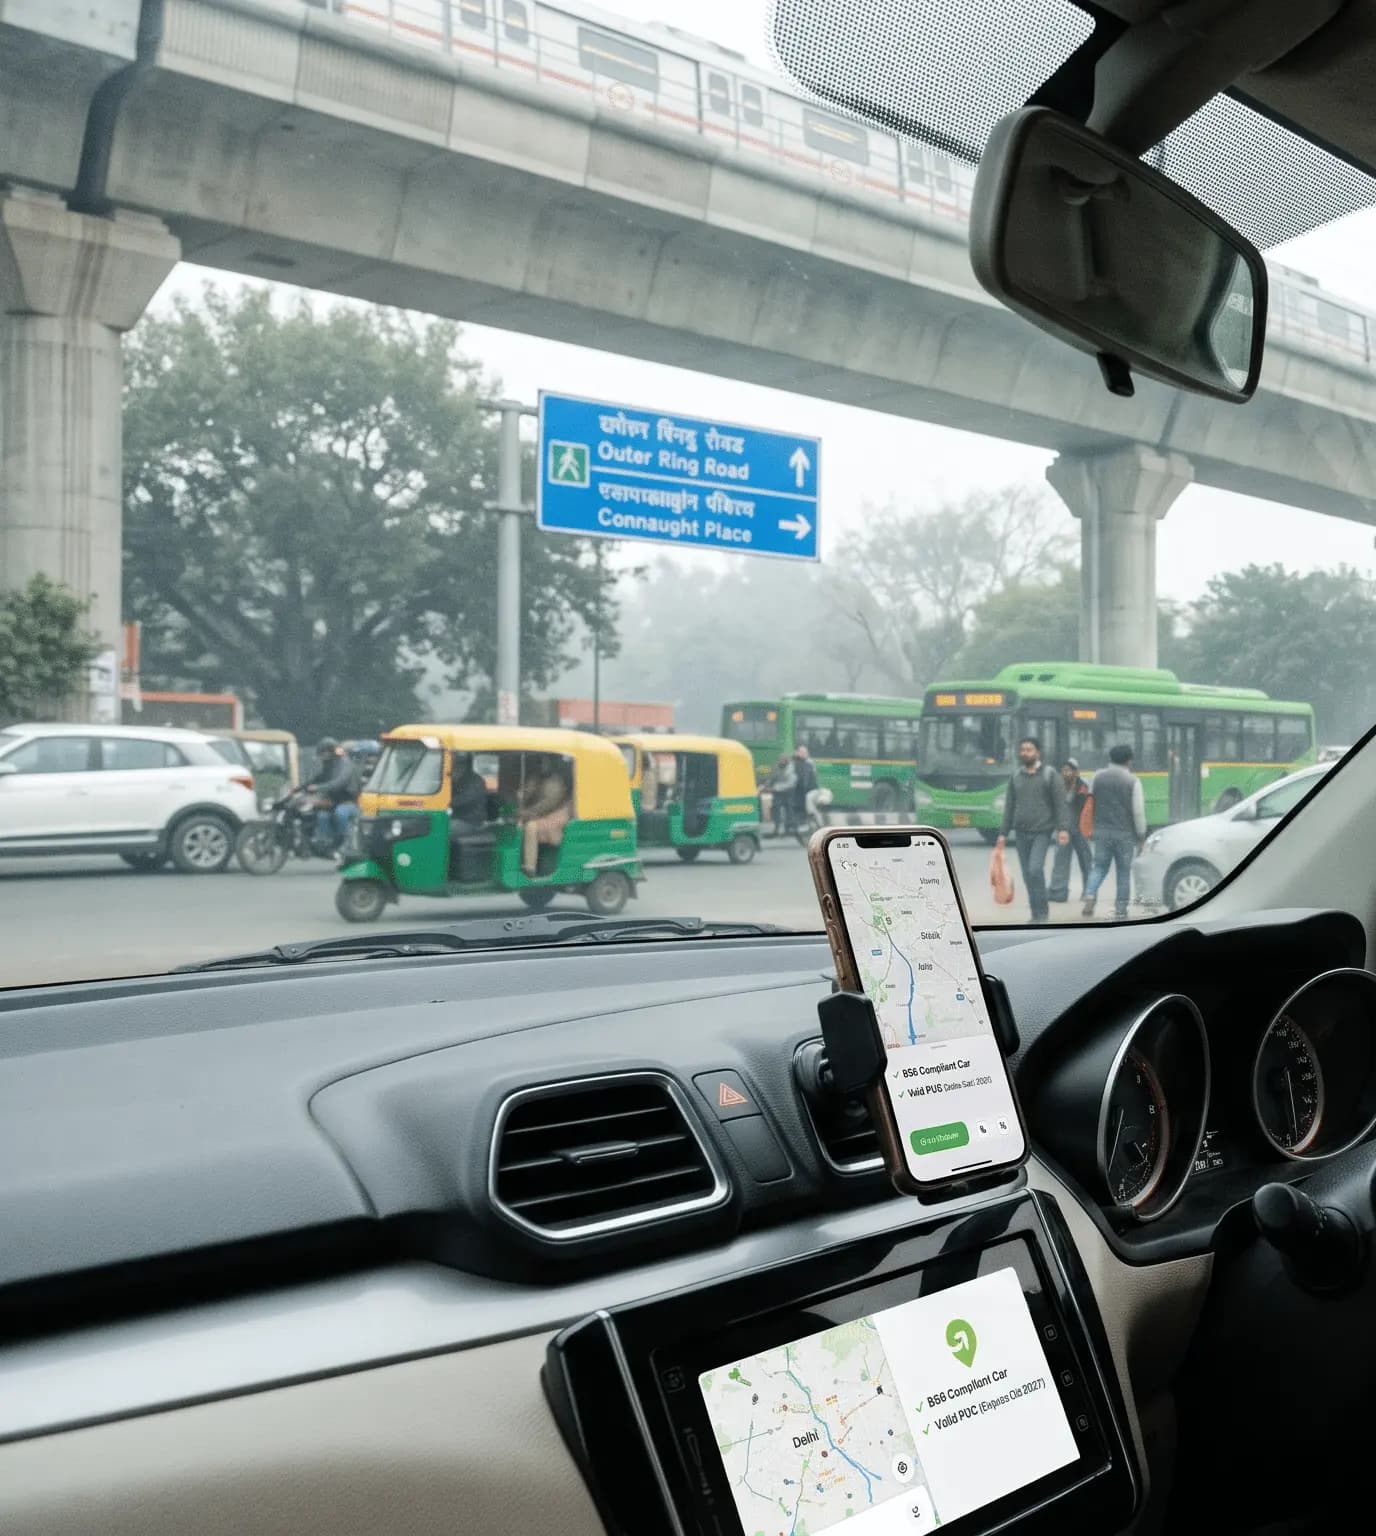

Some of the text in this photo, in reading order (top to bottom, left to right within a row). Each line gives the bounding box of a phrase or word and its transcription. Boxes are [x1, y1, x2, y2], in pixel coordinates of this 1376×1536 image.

[598, 440, 749, 480] Outer Ring Road
[598, 507, 753, 543] Connaught Place
[957, 1059, 971, 1069] Car
[992, 1368, 1008, 1382] Car
[792, 1431, 820, 1448] Delhi
